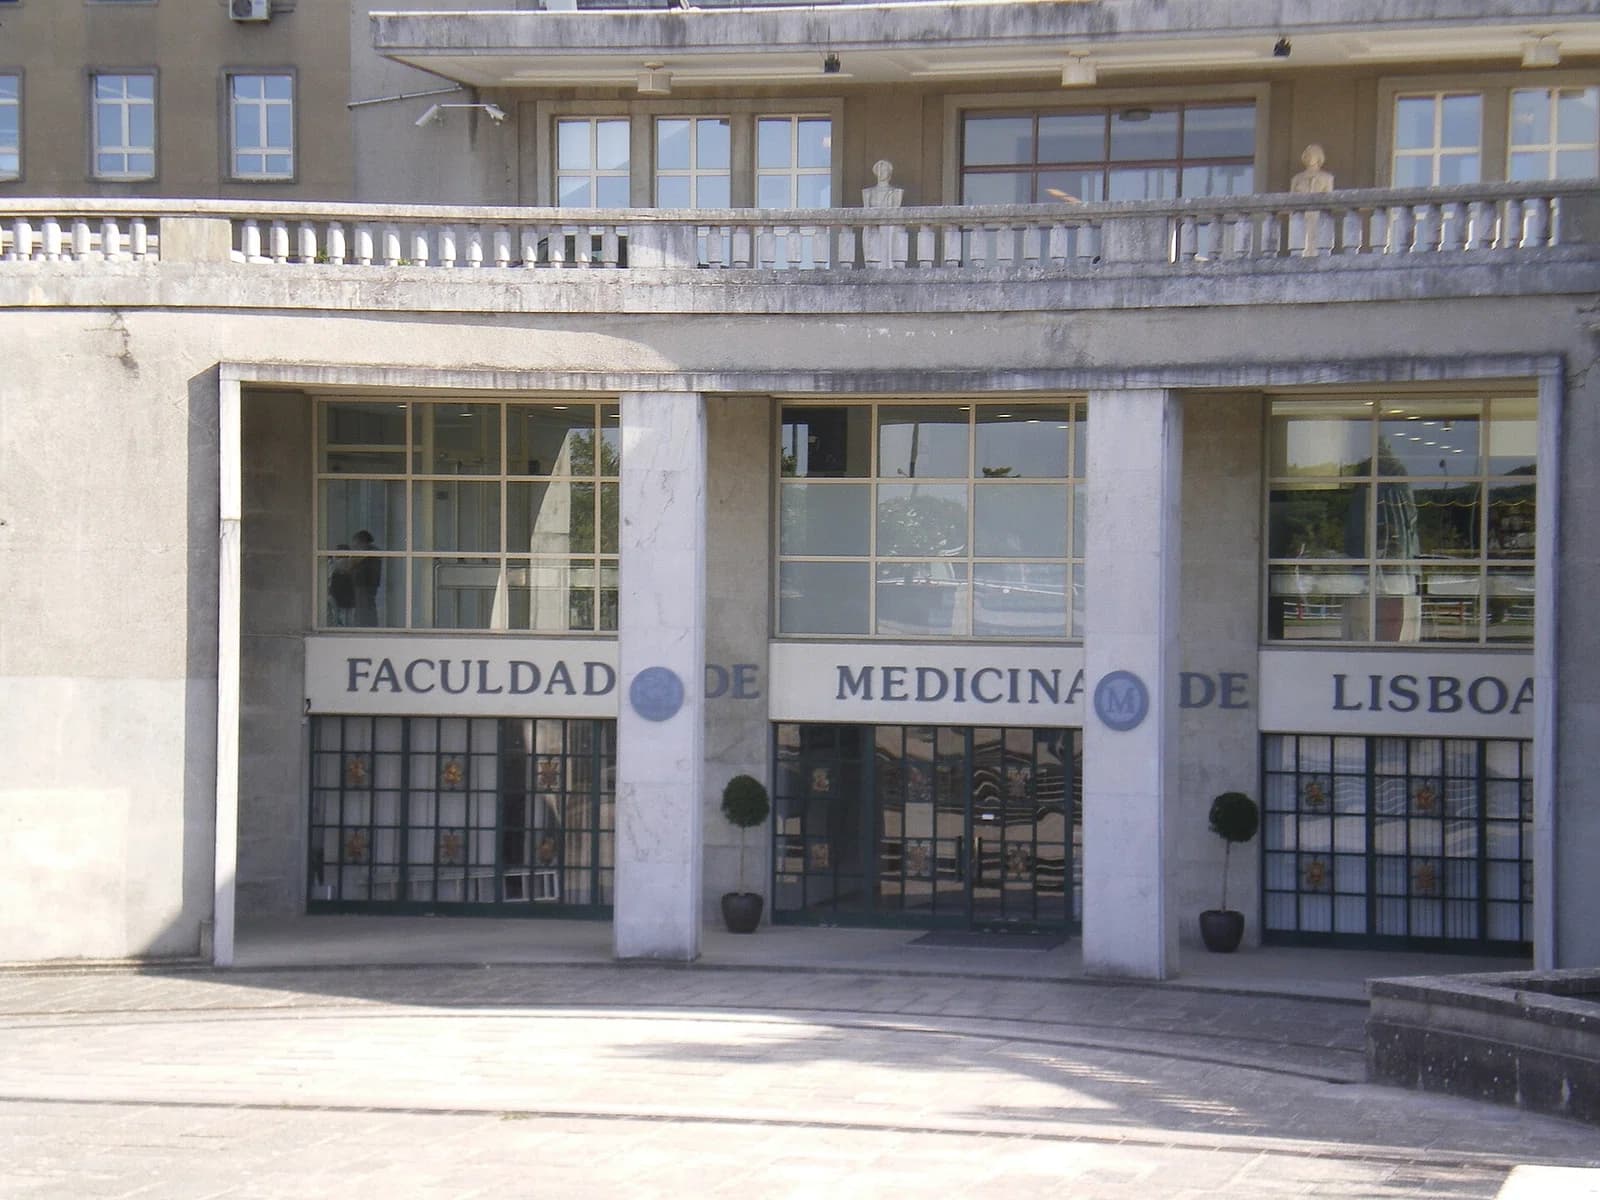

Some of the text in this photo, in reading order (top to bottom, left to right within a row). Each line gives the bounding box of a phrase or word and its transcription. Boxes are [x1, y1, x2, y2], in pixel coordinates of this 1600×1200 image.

[704, 664, 761, 699] DE
[1179, 672, 1249, 709] DE
[1332, 673, 1534, 715] LISBOA
[1105, 687, 1136, 714] M
